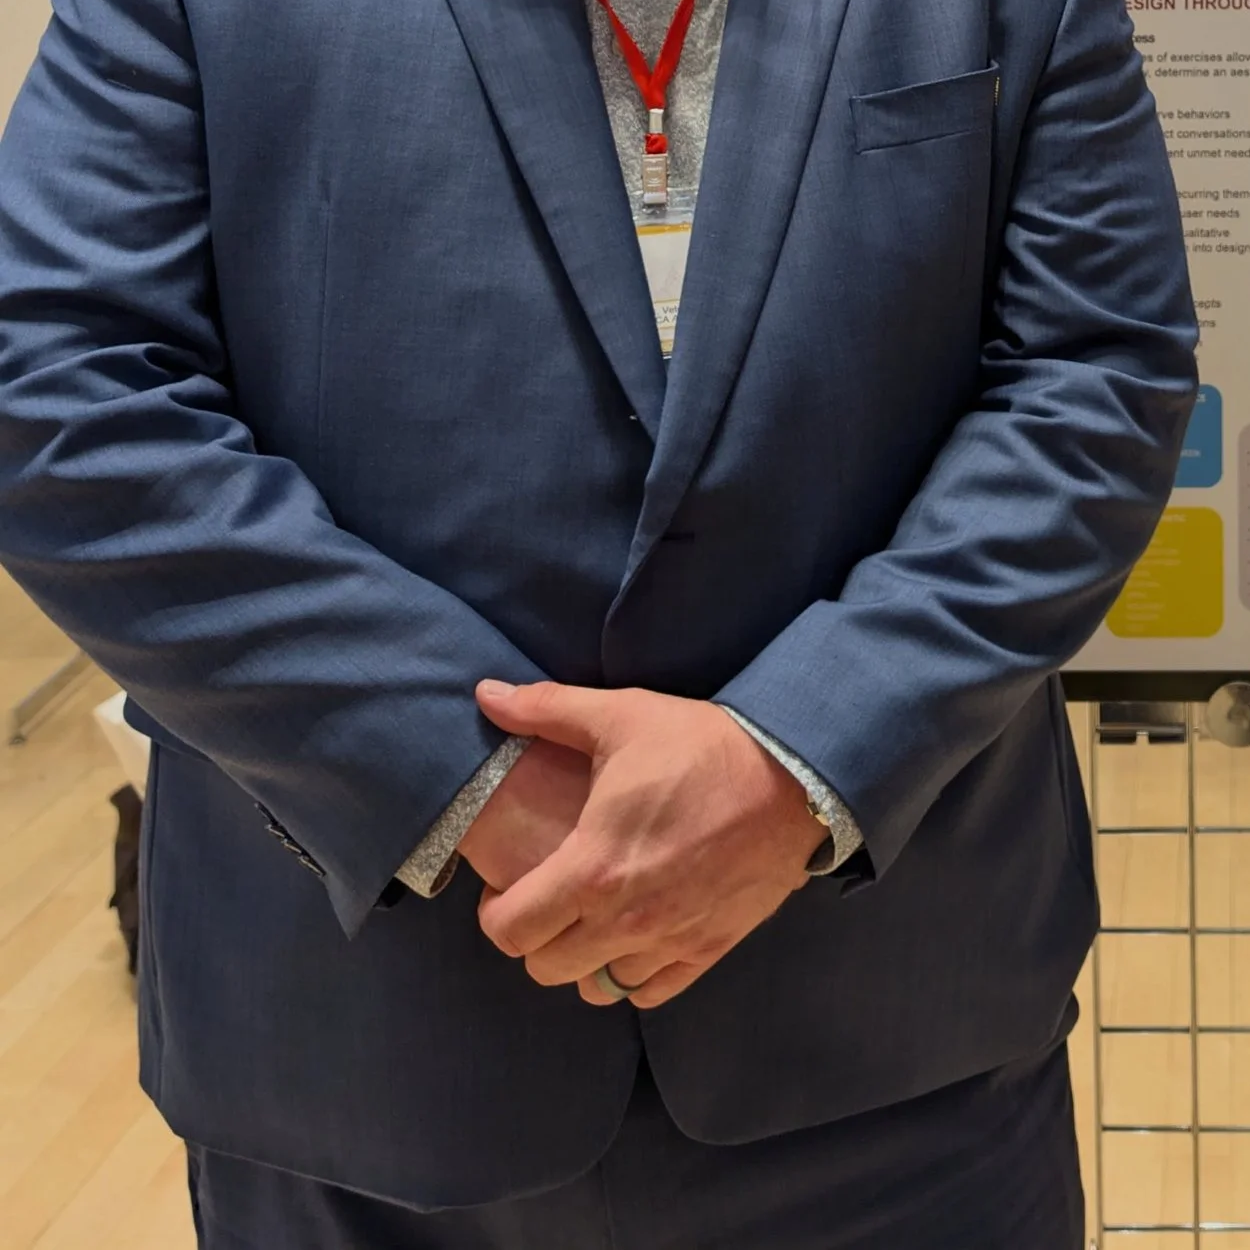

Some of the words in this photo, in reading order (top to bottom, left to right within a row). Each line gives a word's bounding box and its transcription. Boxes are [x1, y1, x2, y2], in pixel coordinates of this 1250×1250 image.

[1156, 51, 1168, 62] of
[1169, 53, 1223, 62] exercises
[1154, 67, 1209, 77] determine
[1213, 68, 1227, 77] an
